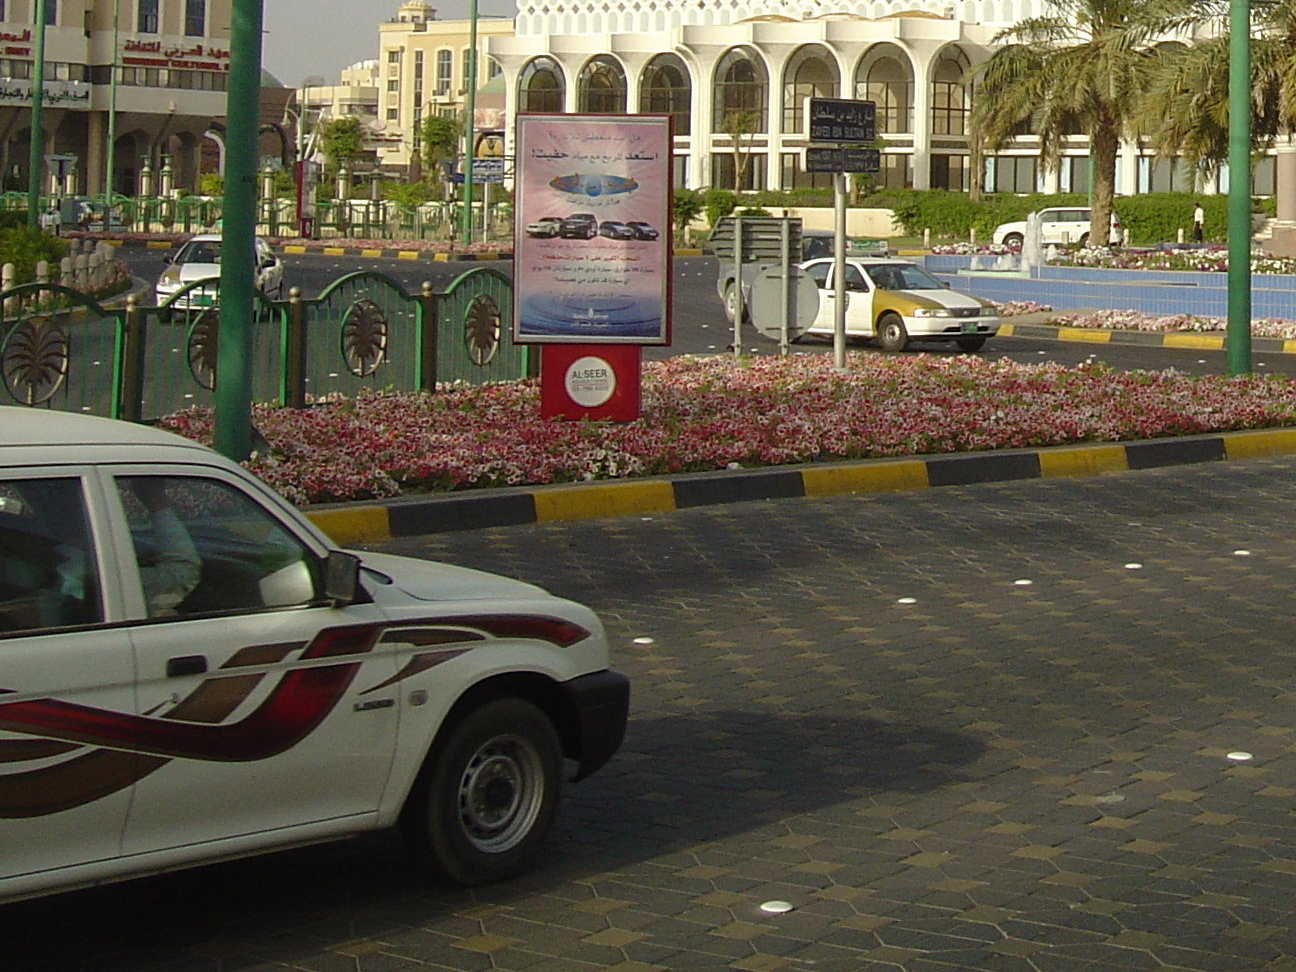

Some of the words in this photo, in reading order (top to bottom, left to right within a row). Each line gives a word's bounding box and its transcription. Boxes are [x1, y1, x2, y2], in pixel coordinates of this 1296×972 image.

[812, 105, 836, 120] سلطان
[843, 126, 865, 138] SULTAN
[625, 150, 659, 161] استعد
